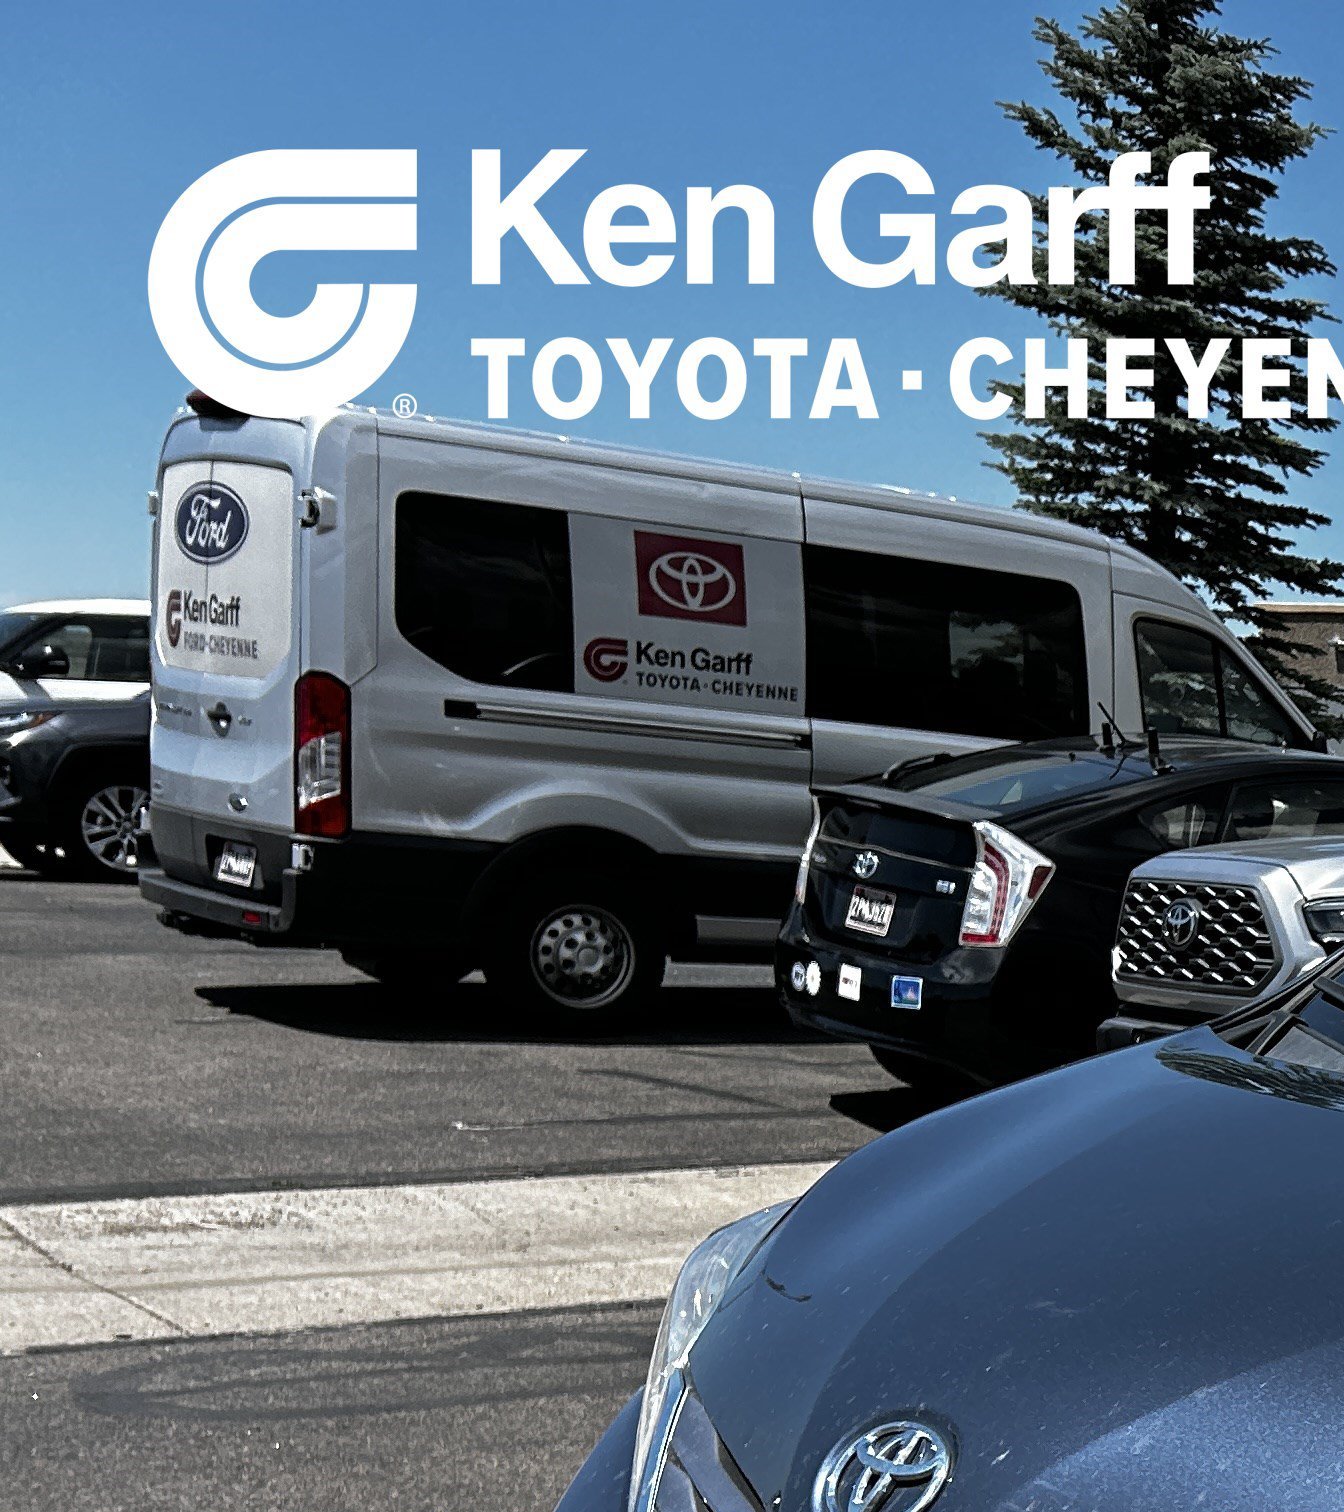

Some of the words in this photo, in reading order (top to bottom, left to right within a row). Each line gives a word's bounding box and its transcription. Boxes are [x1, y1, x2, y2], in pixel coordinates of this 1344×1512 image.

[186, 493, 231, 549] Ford
[184, 590, 207, 624] Ken
[209, 594, 240, 627] Garff
[208, 634, 258, 659] CHEYENNE
[636, 640, 685, 669] Ken
[690, 647, 753, 676] Garff
[636, 671, 701, 693] TOYOTA
[711, 678, 799, 702] CHEYENNE
